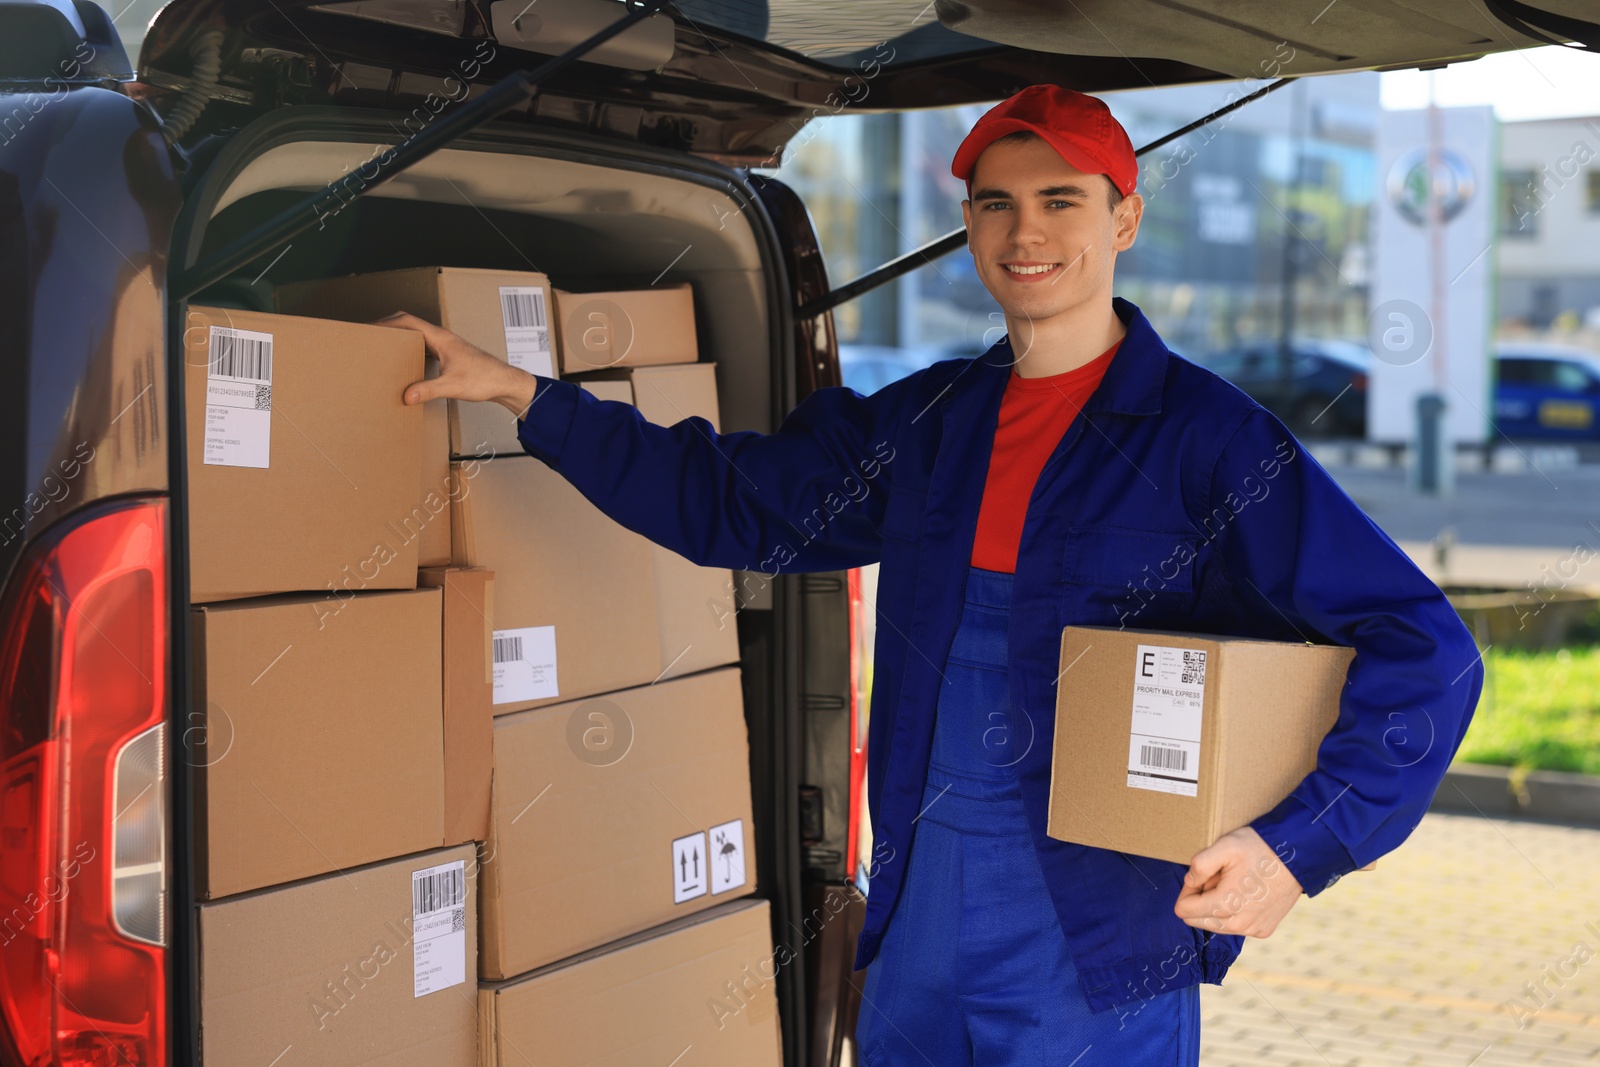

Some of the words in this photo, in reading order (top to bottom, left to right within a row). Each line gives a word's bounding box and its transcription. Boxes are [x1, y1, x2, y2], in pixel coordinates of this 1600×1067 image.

[1142, 652, 1155, 677] E
[1136, 685, 1161, 694] PRIORITY
[1162, 688, 1174, 696] MAIL
[1175, 690, 1201, 699] EXPRESS
